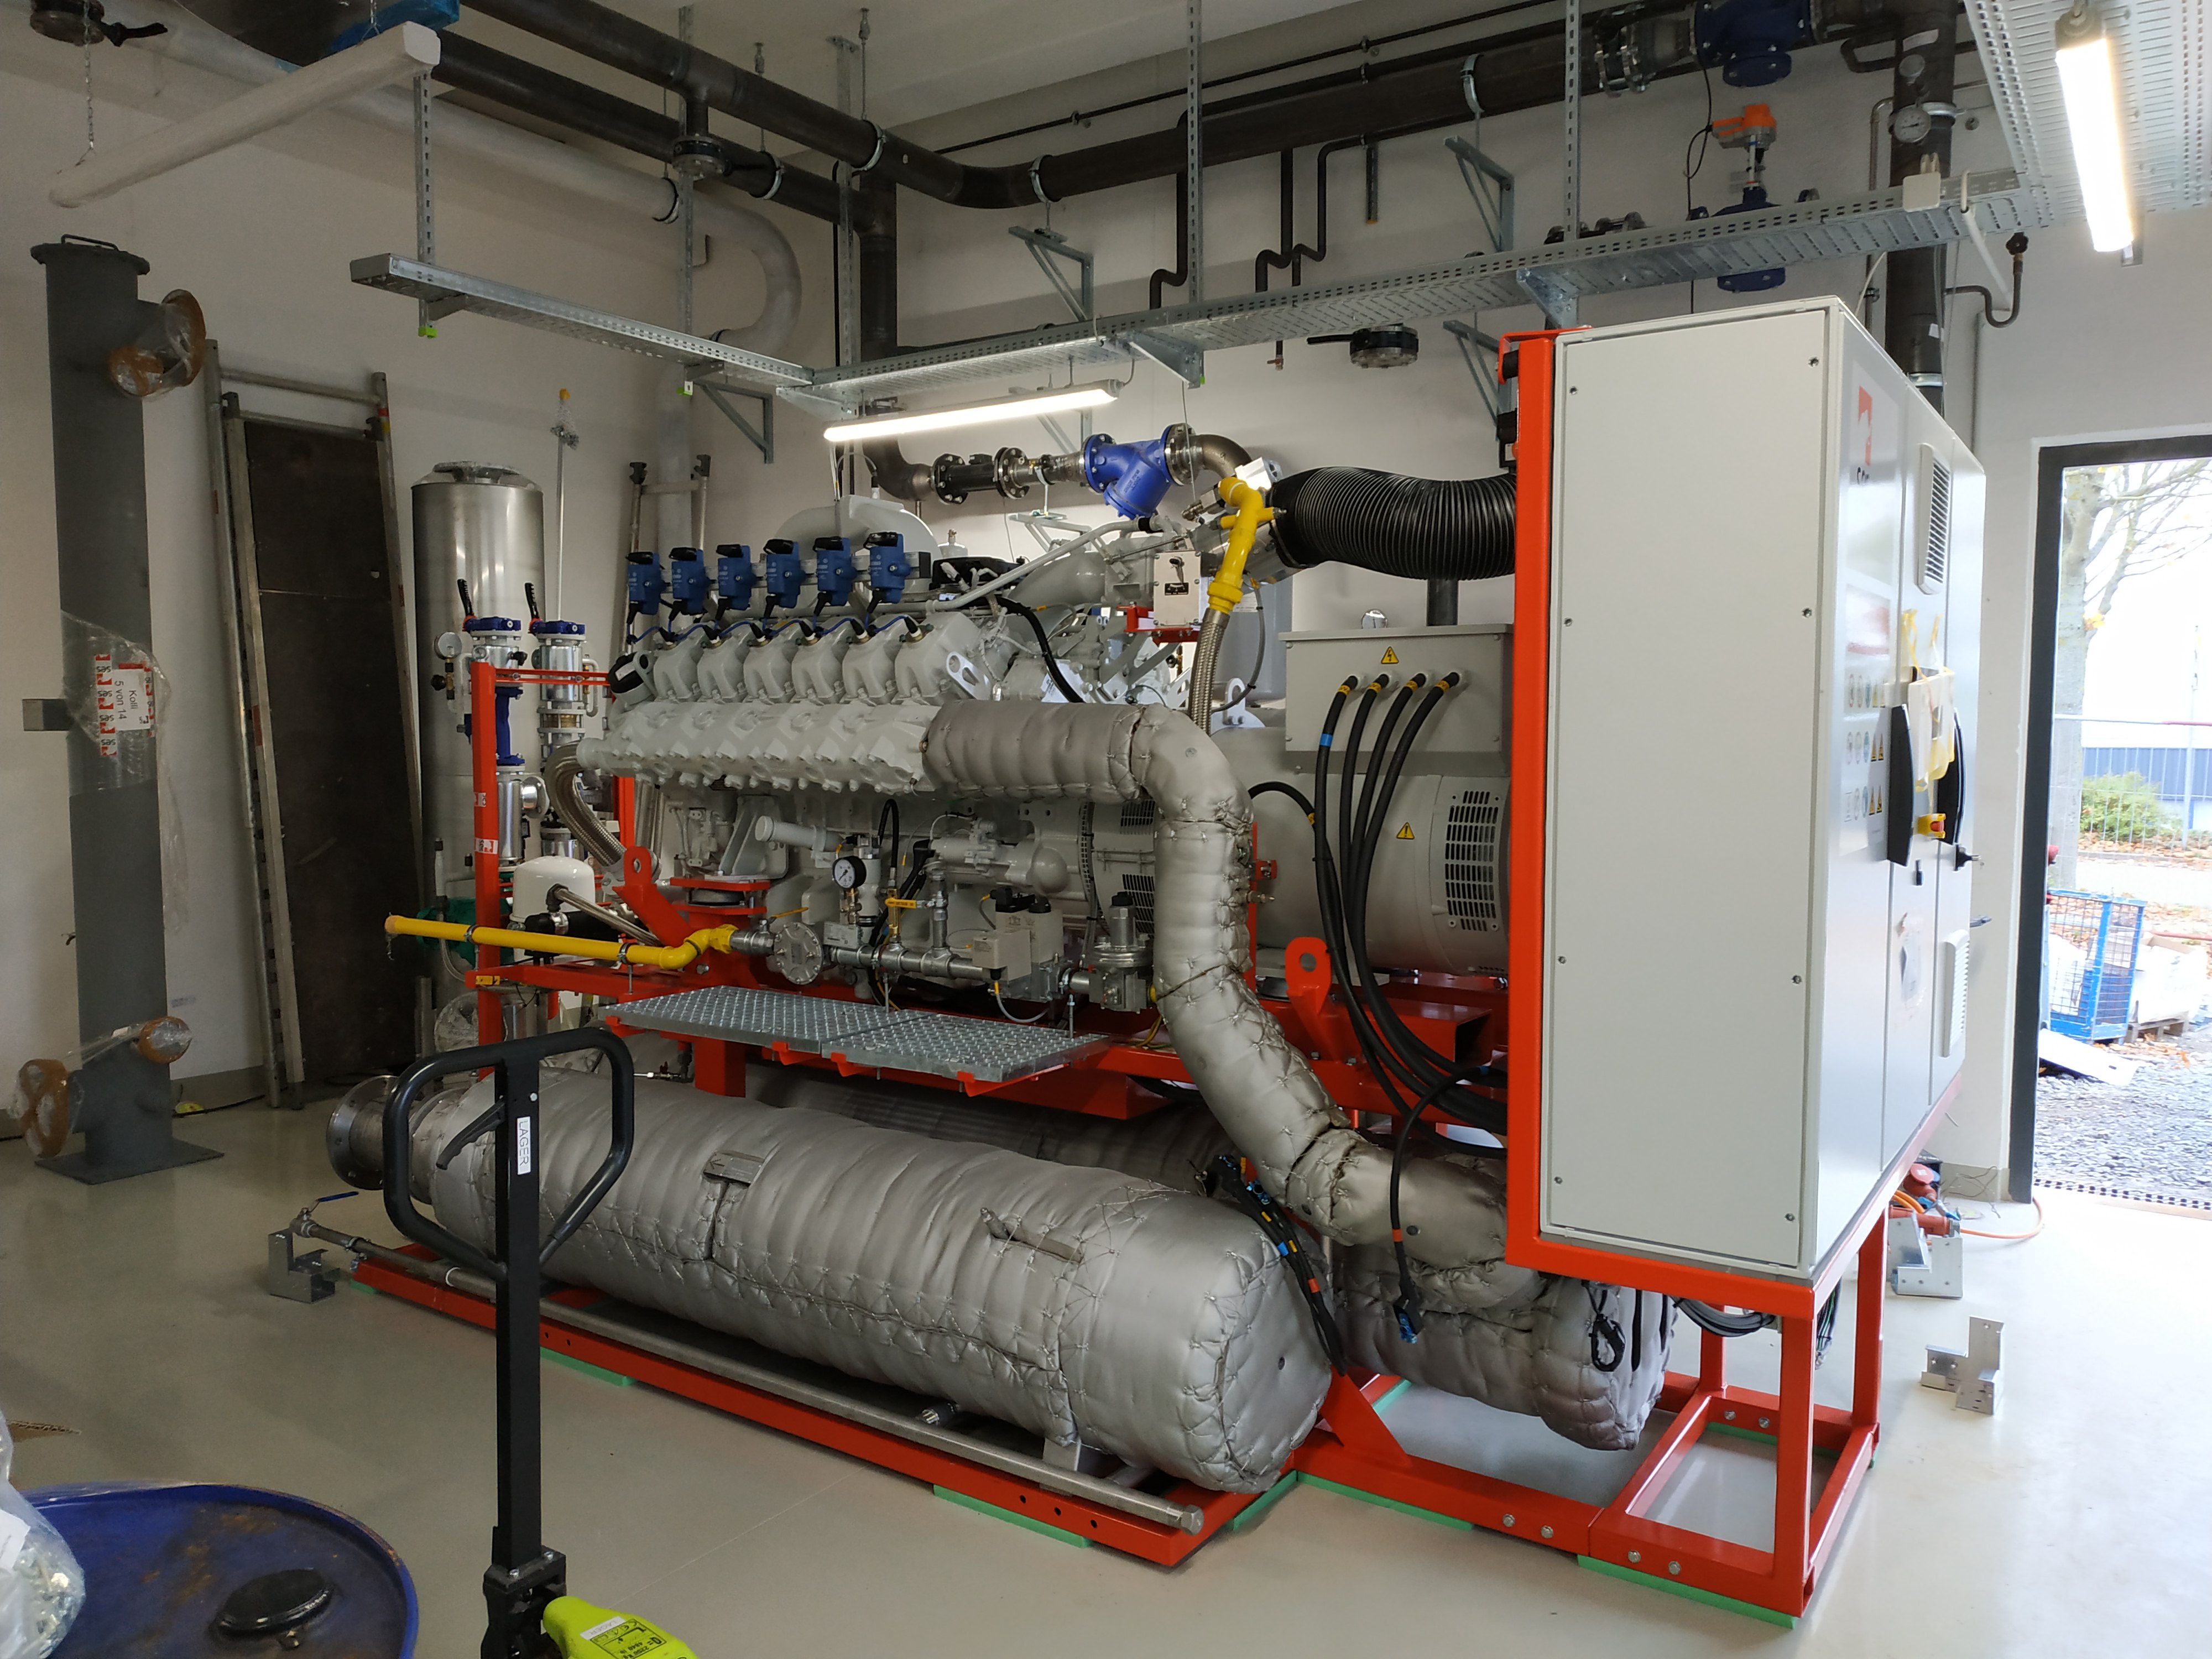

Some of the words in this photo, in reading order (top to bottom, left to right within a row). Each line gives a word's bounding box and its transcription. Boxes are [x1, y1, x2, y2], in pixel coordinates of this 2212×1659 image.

[116, 689, 124, 706] von
[128, 690, 138, 709] Kolli
[118, 709, 127, 719] 14
[519, 1120, 529, 1166] LAGER
